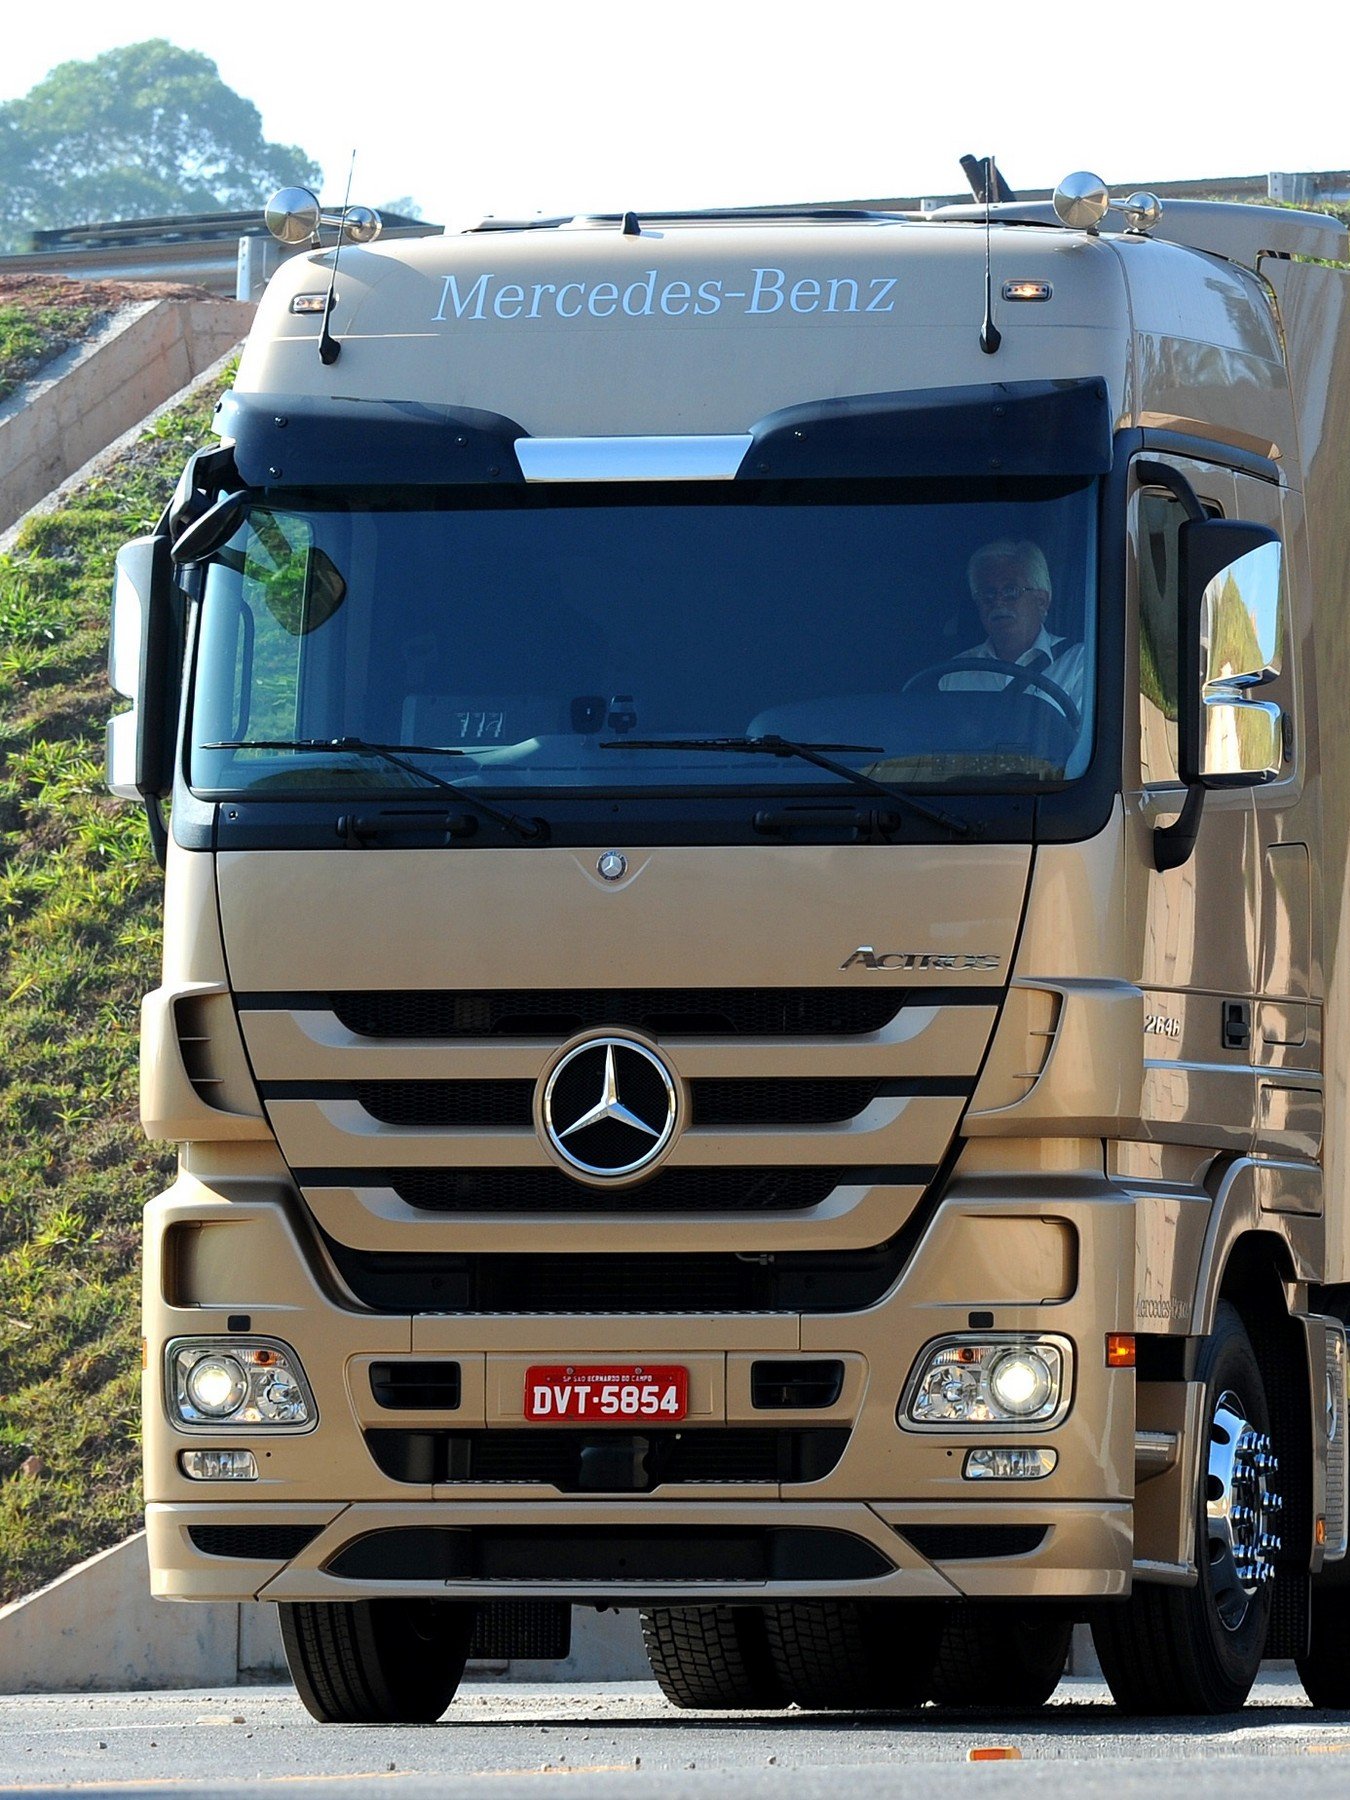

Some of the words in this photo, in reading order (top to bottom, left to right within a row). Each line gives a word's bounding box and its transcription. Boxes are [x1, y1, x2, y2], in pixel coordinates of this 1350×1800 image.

[431, 268, 898, 321] Mercedes-Benz
[838, 945, 1001, 971] ACTROS
[1144, 1014, 1181, 1037] 2646
